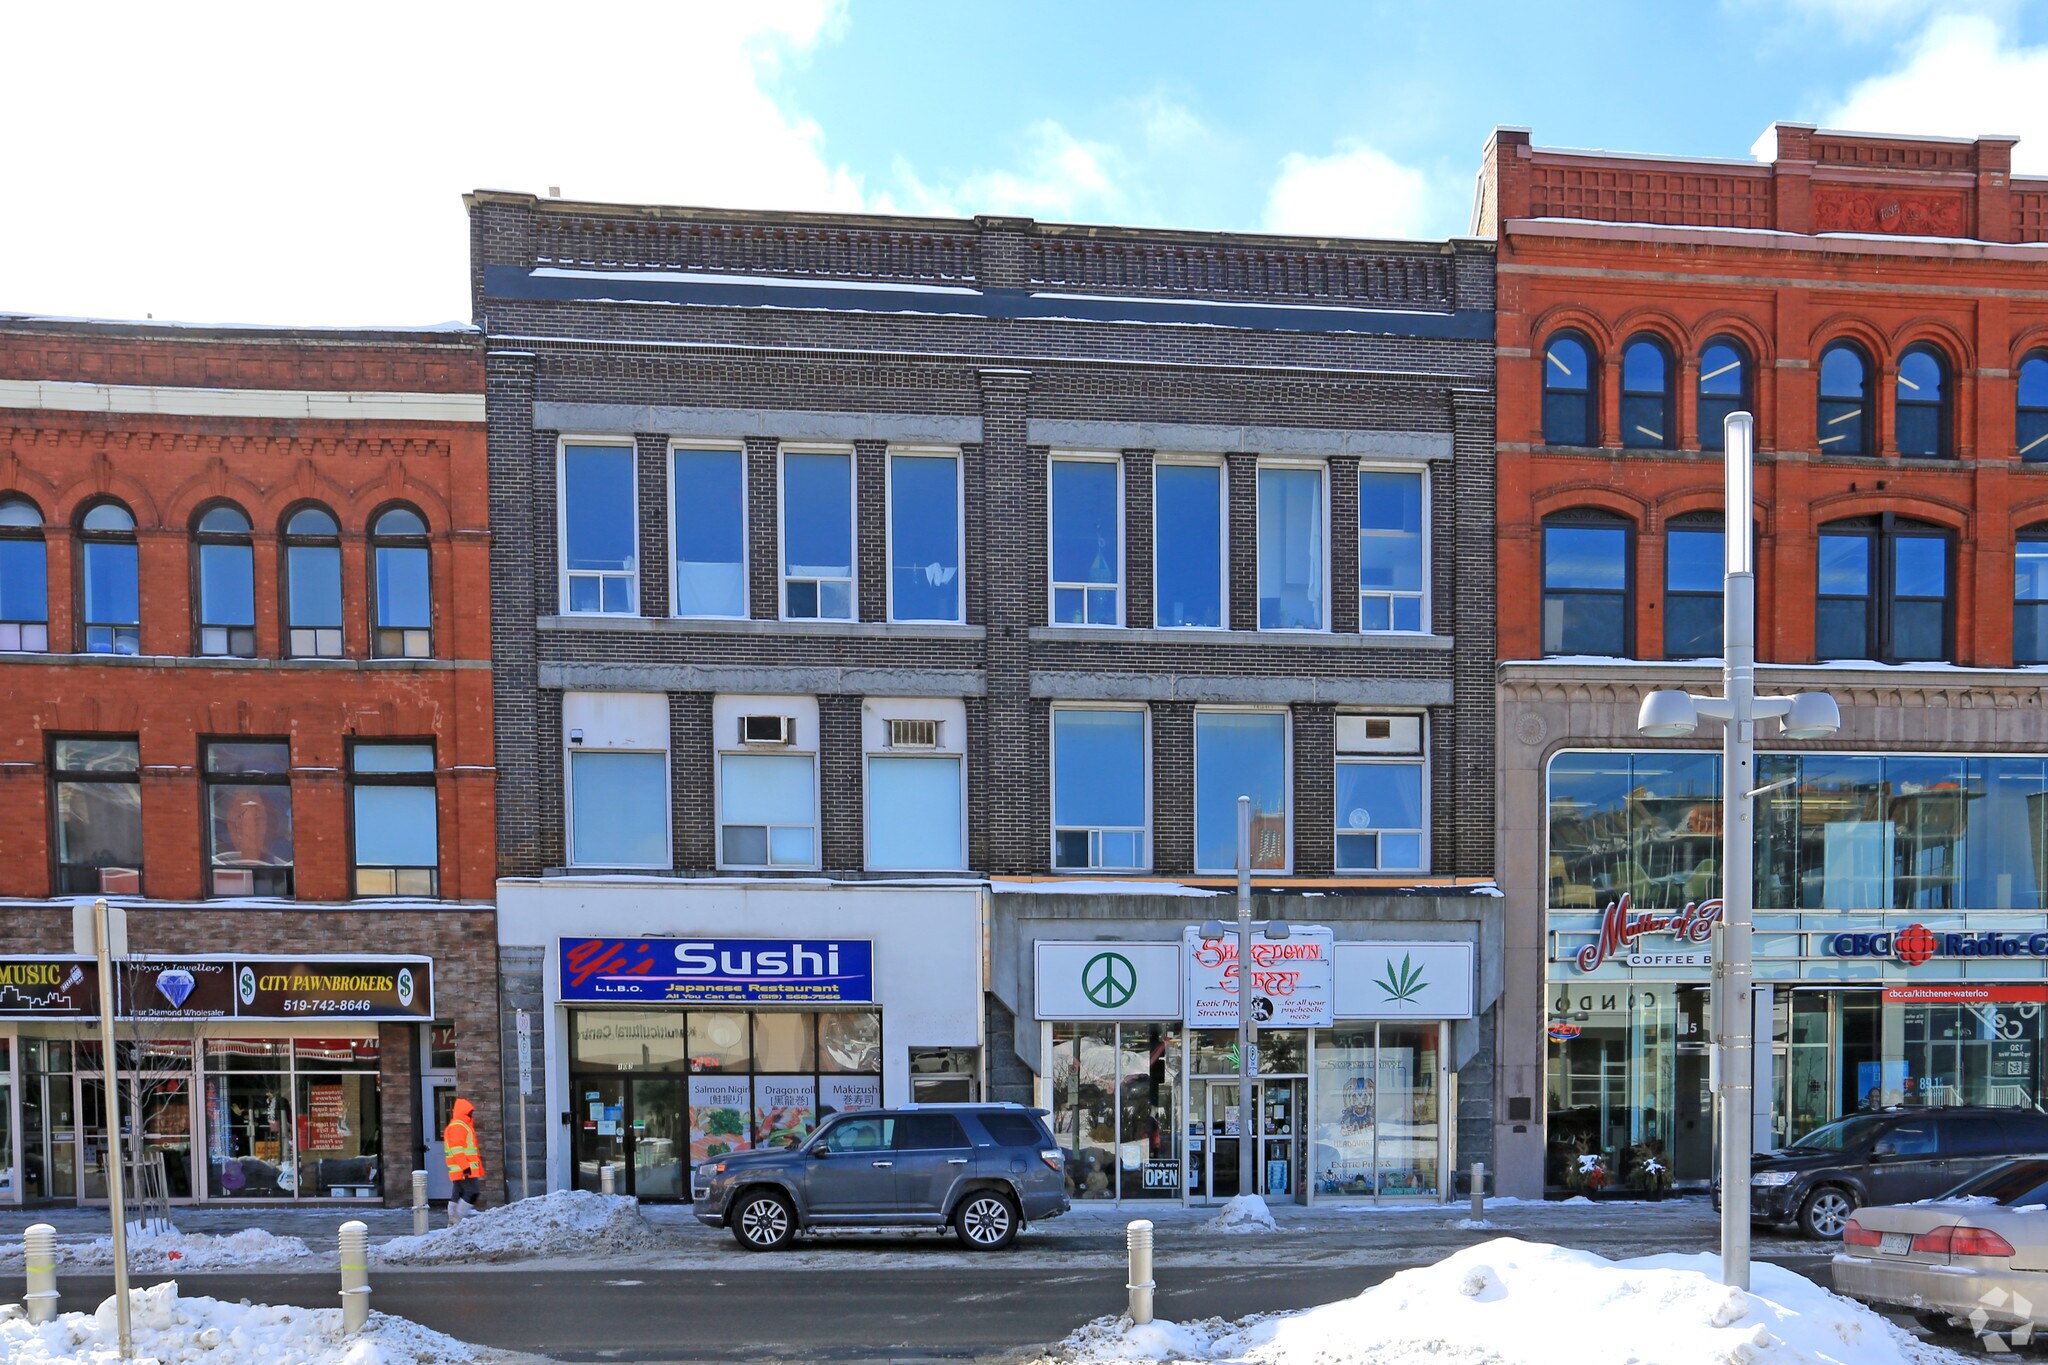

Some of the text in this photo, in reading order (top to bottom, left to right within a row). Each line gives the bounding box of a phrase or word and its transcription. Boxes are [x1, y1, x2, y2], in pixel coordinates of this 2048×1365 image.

[1670, 902, 1695, 941] of
[1834, 932, 1890, 957] CBC
[674, 943, 839, 975] Sushi
[1631, 955, 1695, 964] COFFEE
[0, 964, 61, 985] MUSIC
[259, 975, 393, 991] CITY PAWNBROKERS
[665, 984, 839, 993] Japanese Restaurant
[1889, 990, 1989, 999] cbc.ca/kitchener-waterloo
[284, 1000, 370, 1011] 519-742-8646
[1222, 1000, 1239, 1008] Pipe
[1549, 1024, 1582, 1034] OPEN
[694, 1085, 749, 1097] Salmon Nigir
[765, 1085, 815, 1096] Dragon roll
[833, 1085, 880, 1094] Makizushi
[1145, 1169, 1178, 1186] OPEN
